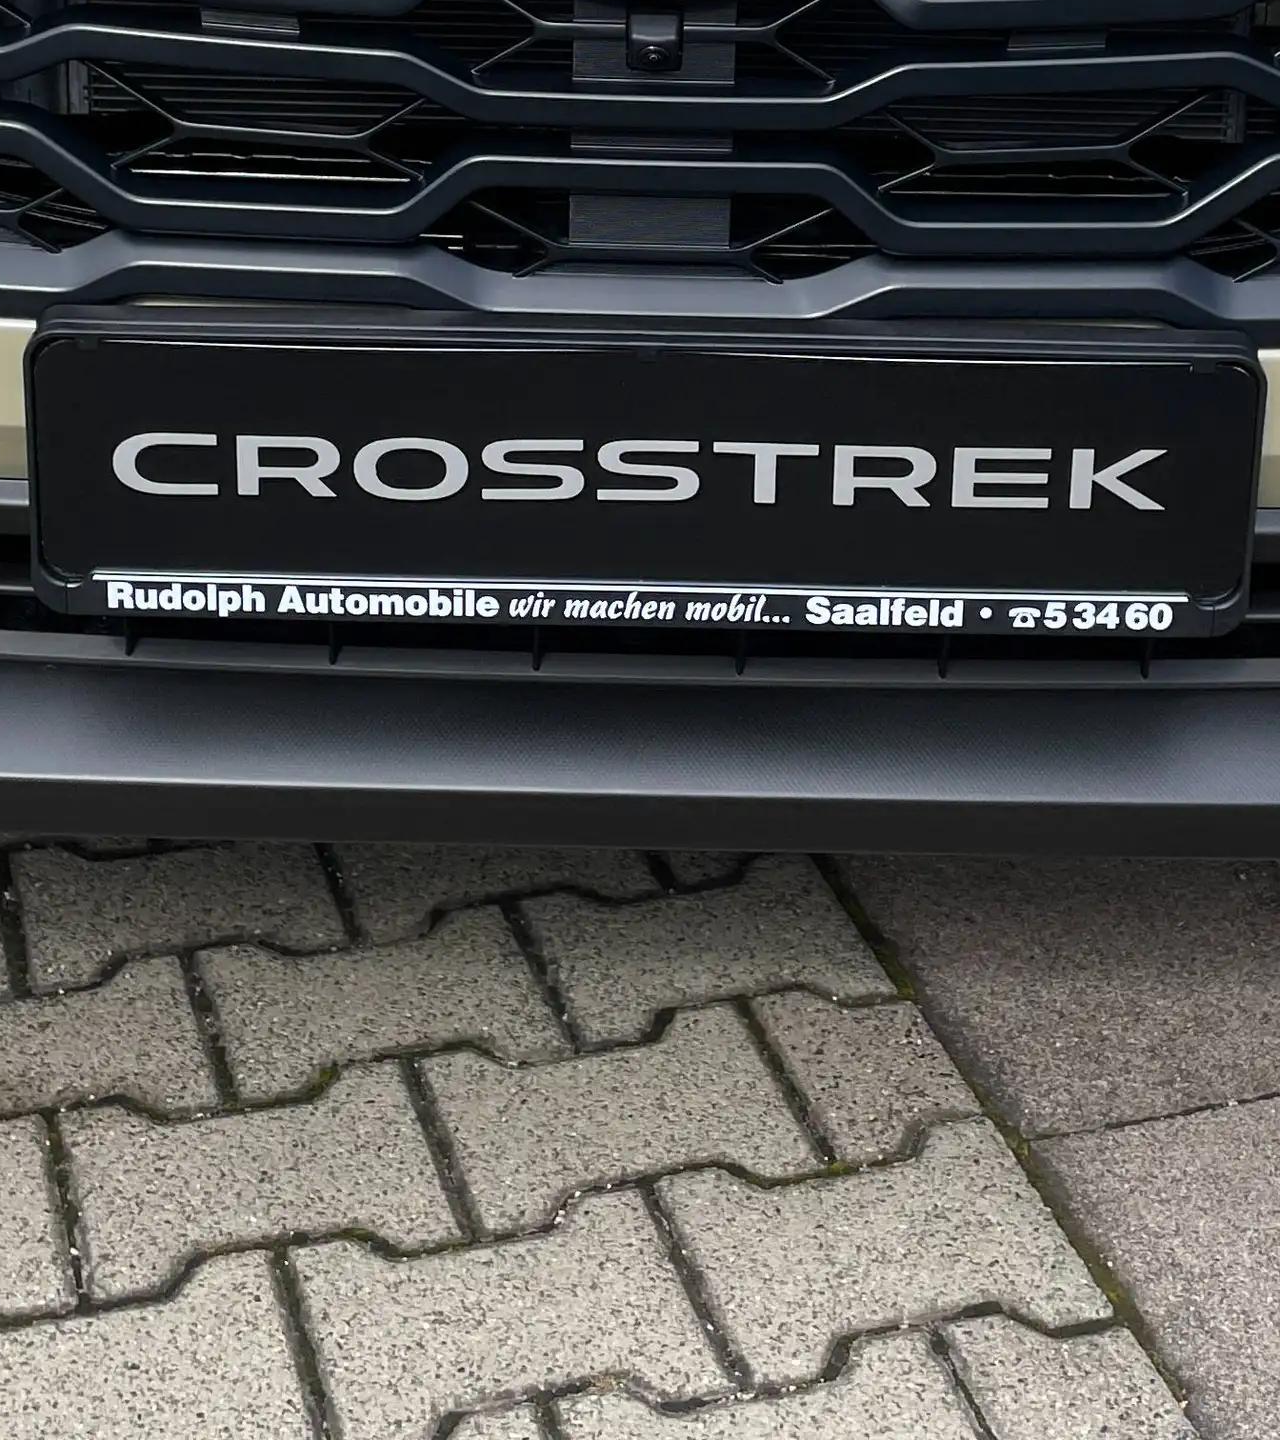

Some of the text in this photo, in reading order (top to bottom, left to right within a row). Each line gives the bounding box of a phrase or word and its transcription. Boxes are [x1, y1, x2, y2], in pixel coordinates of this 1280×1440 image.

[112, 431, 1168, 512] CROSSTREK
[106, 581, 266, 617] Rudolph
[276, 584, 500, 617] Automobile
[508, 591, 556, 618] wir
[563, 591, 676, 621] machen
[685, 593, 791, 624] mobil...
[805, 596, 965, 627] Saalfeld
